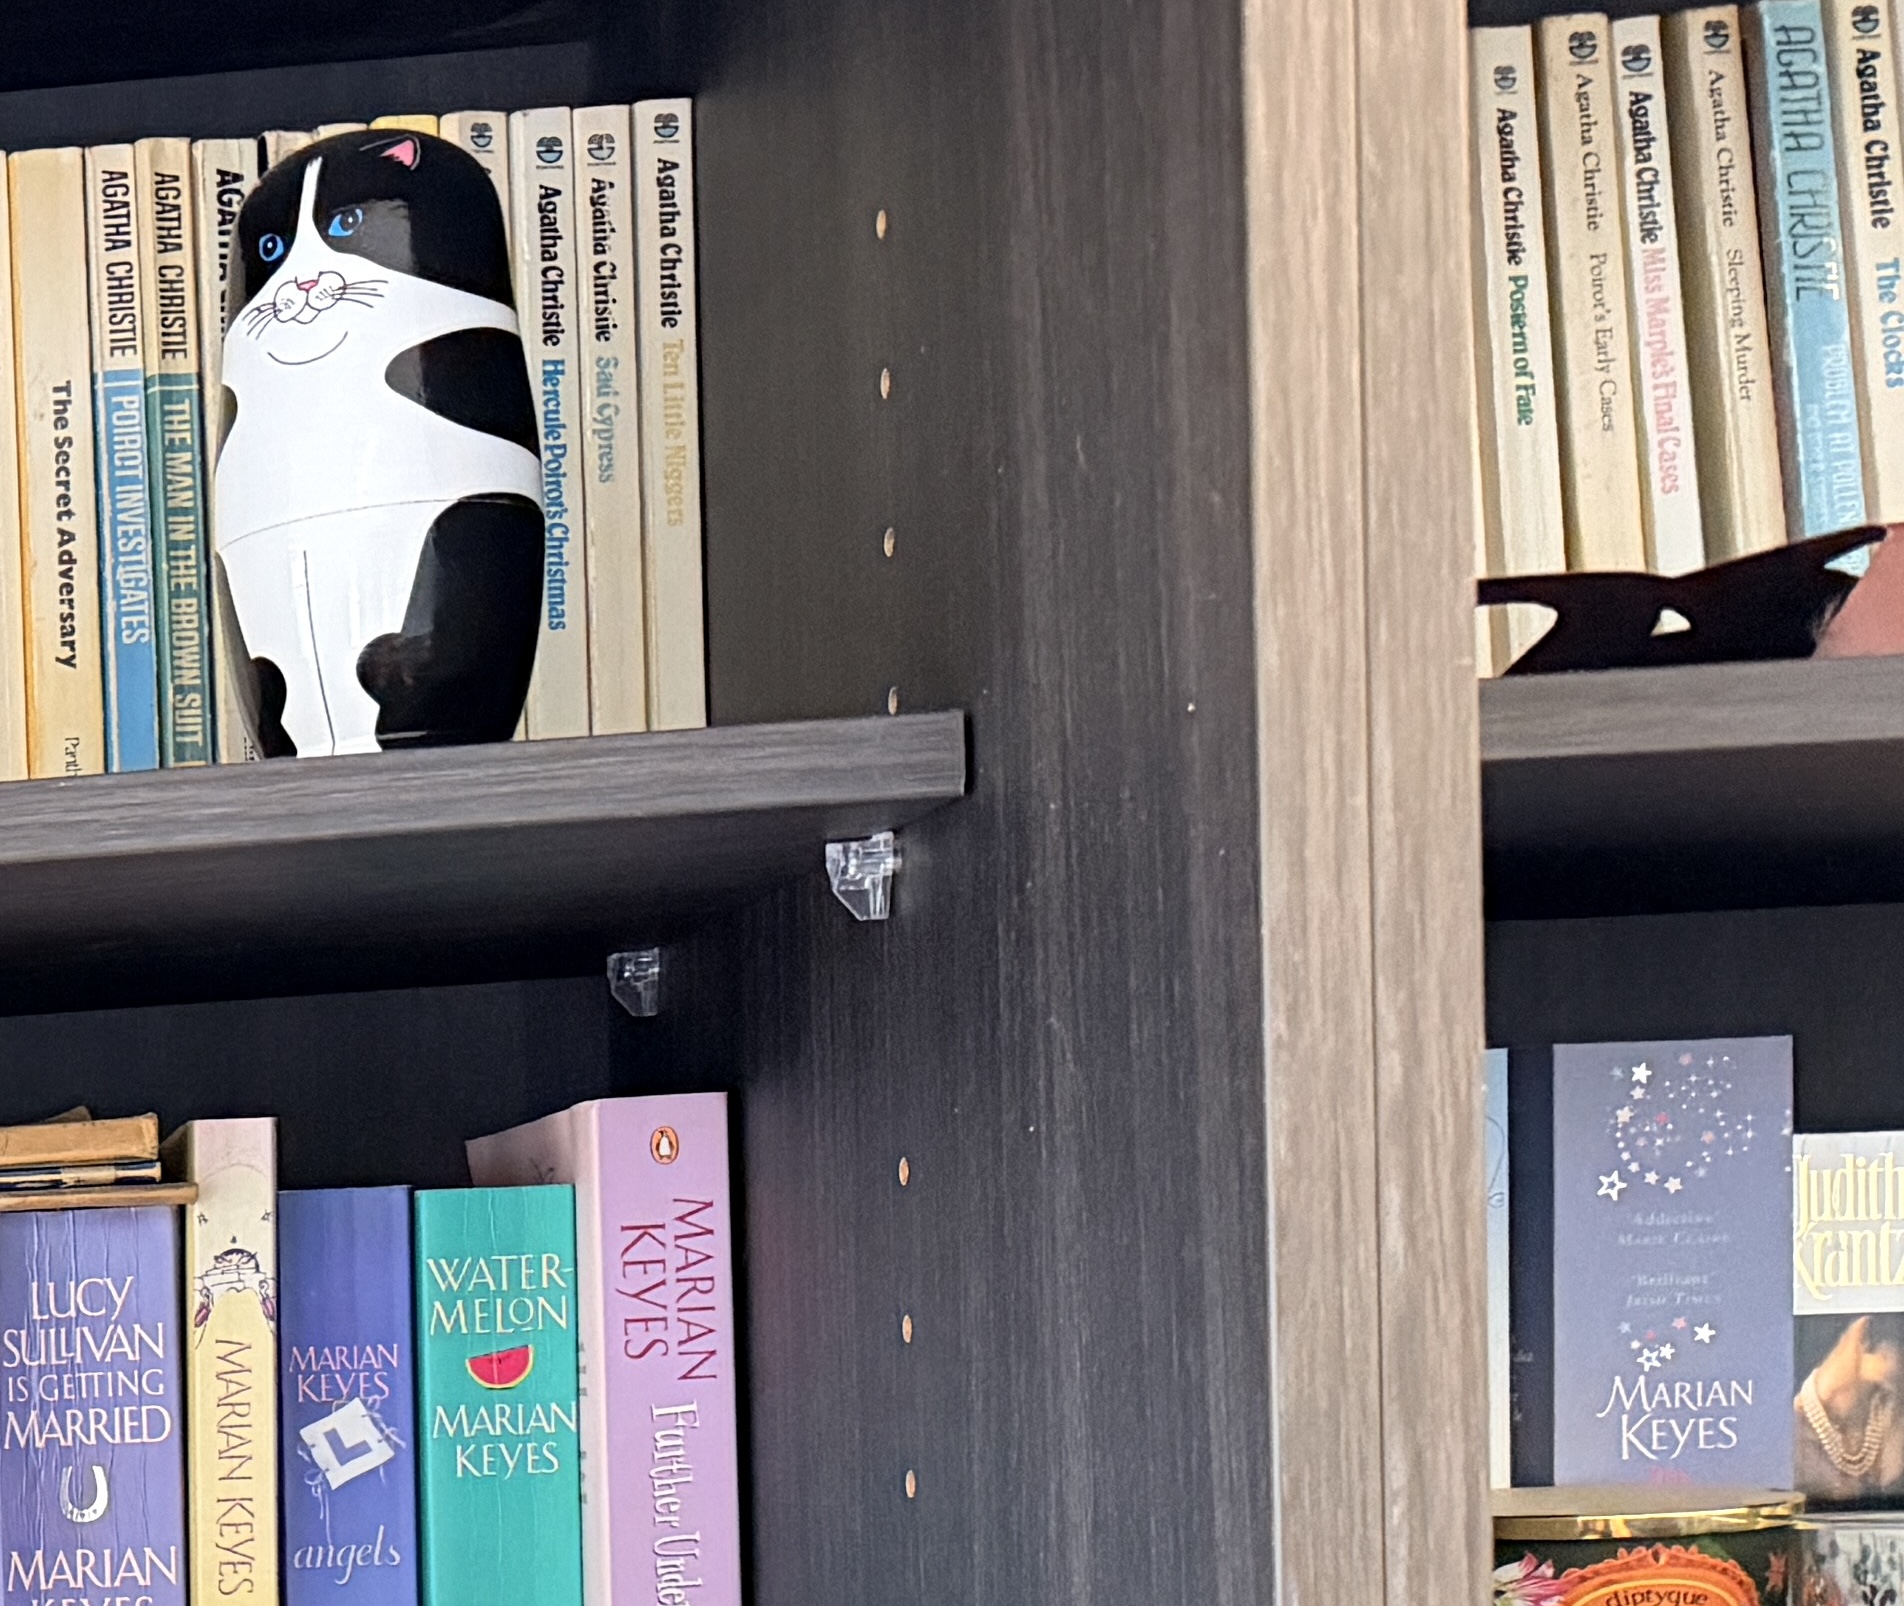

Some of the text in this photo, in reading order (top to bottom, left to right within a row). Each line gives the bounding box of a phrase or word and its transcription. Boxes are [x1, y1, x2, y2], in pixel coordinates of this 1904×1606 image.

[1496, 108, 1517, 183] Agatha
[1502, 187, 1523, 266] Christie
[102, 170, 150, 645] AGATHA CHRISTIE POIROT INVESTIGATES
[52, 380, 76, 669] The Secret Adversary
[31, 1277, 134, 1321] LUCY
[615, 1225, 667, 1360] KEYES
[671, 1199, 717, 1382] MARIAN
[430, 1296, 568, 1335] MELON
[2, 1322, 164, 1368] SULLIVAN
[289, 1344, 398, 1372] MARIAN
[8, 1370, 164, 1402] IS GETTING
[297, 1372, 389, 1402] KEYES
[1596, 1375, 1753, 1418] MARIAN
[3, 1404, 172, 1449] MARRIED
[432, 1400, 577, 1439] MARIAN
[1622, 1413, 1738, 1460] KEYES
[455, 1442, 559, 1479] KEYES
[651, 1400, 699, 1528] Further
[8, 1546, 176, 1592] MARIAN
[294, 1525, 400, 1584] angels
